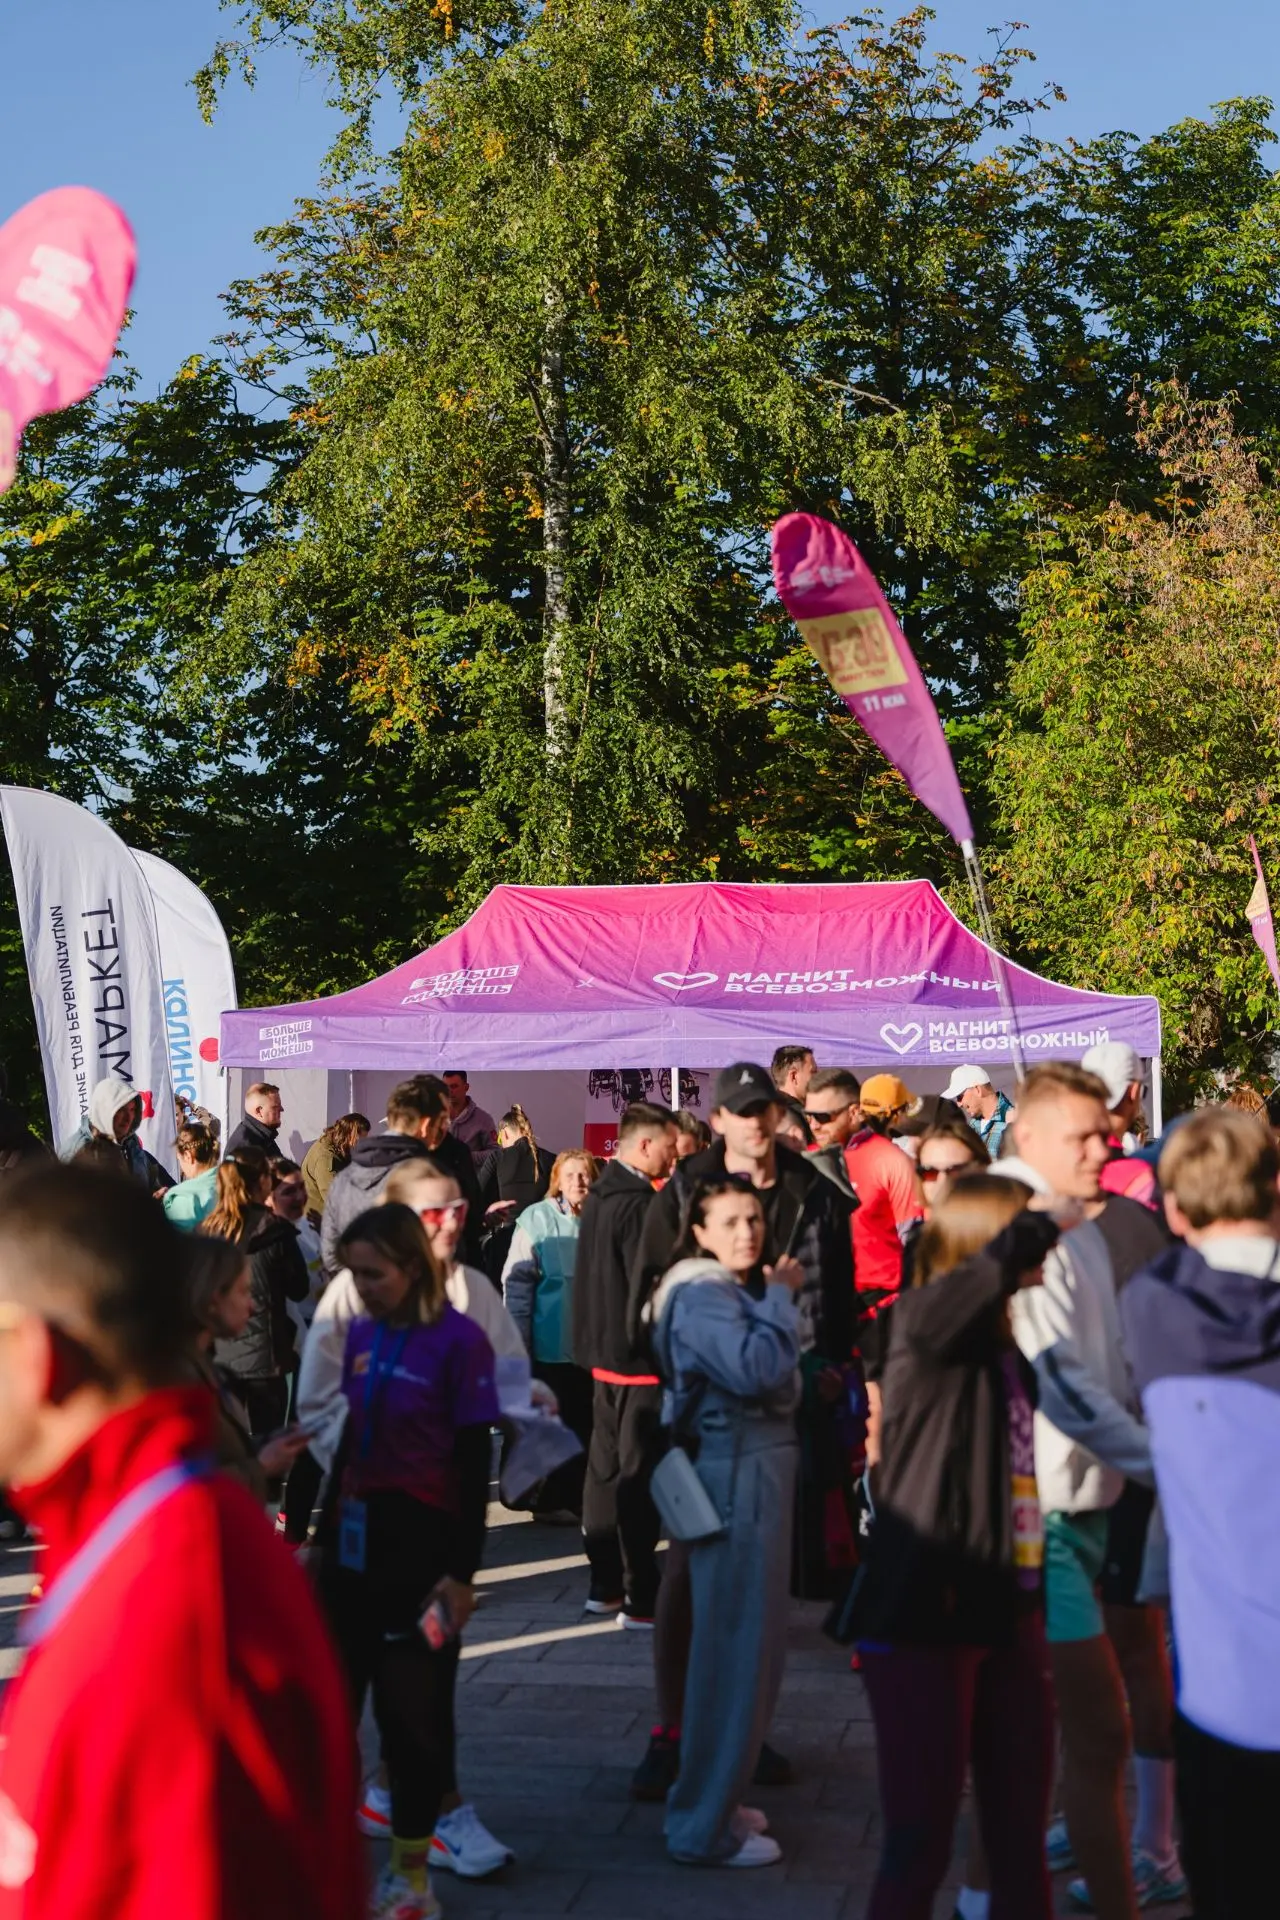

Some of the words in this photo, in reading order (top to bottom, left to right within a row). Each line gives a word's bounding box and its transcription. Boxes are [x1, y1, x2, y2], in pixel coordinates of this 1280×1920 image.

[724, 970, 1001, 994] ВСЕВОЗМОЖНЫЙ
[728, 970, 854, 984] МАГНИТ
[265, 1021, 310, 1038] БОЛЬШЕ
[929, 1020, 1010, 1037] МАГНИТ
[273, 1033, 298, 1046] ЧЕМ
[929, 1026, 1110, 1053] ВСЕВОЗМОЖНЫЙ
[261, 1042, 312, 1060] МОЖЕШЬ
